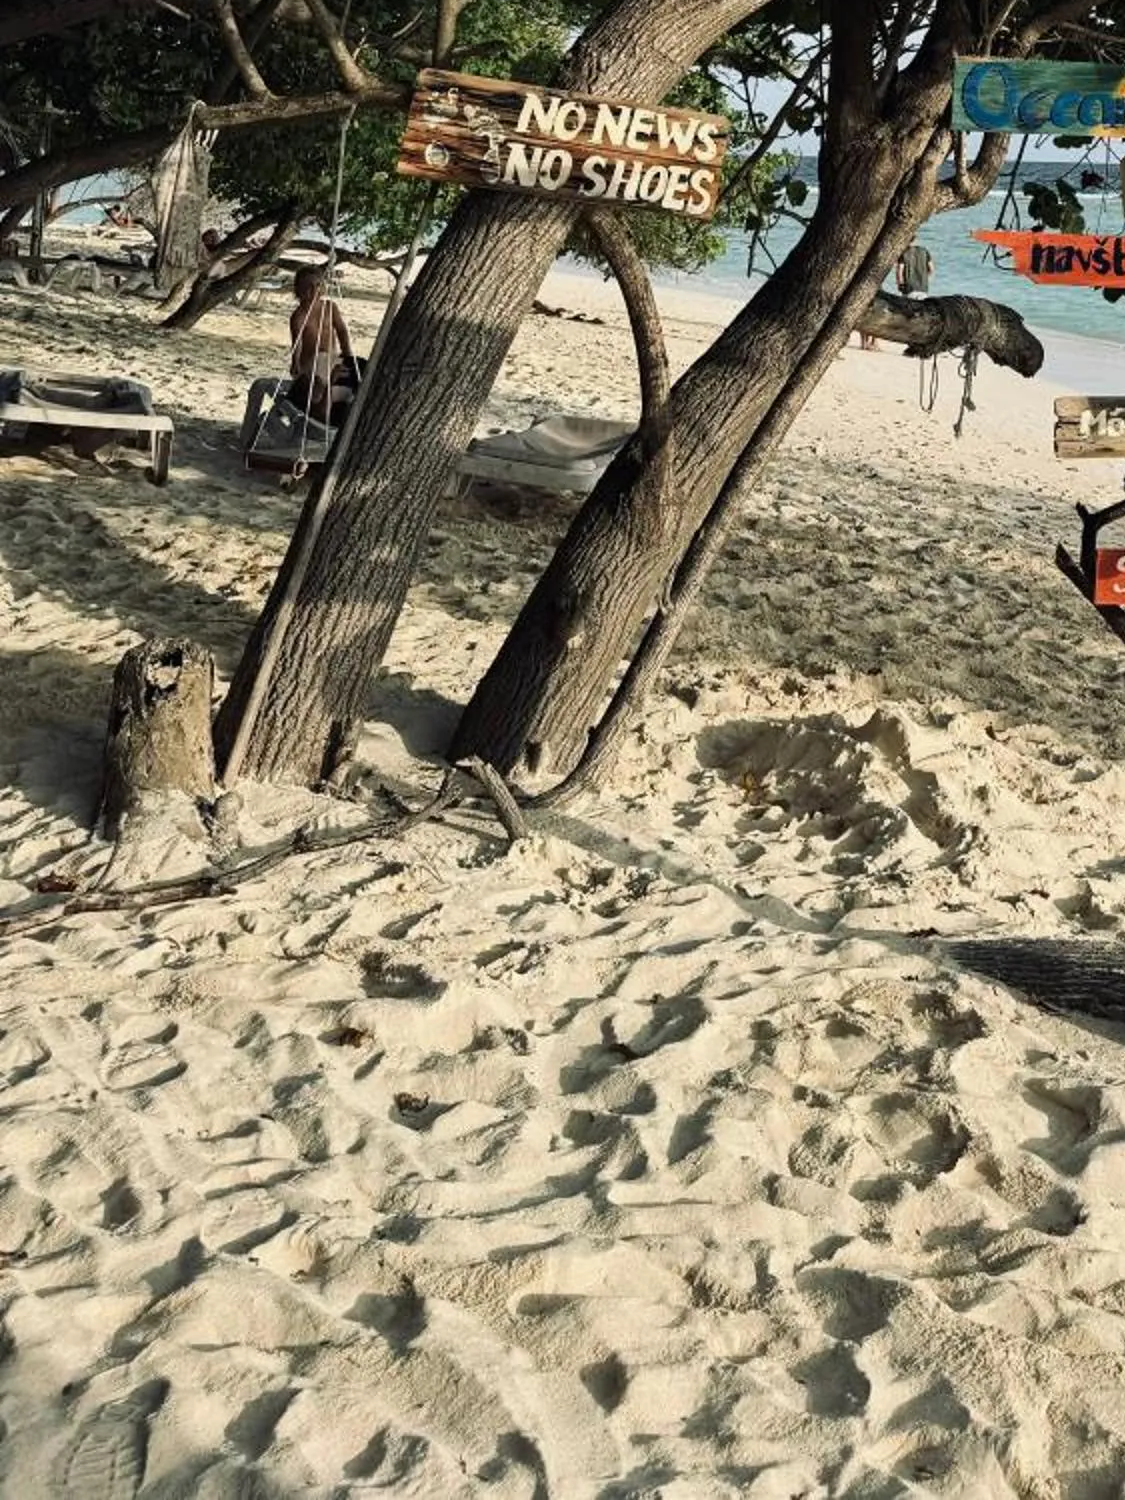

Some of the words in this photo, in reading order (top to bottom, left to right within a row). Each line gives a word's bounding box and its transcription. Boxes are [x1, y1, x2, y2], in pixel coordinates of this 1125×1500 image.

[516, 92, 588, 142] NO
[590, 103, 719, 163] NEWS
[503, 142, 574, 192] NO
[577, 155, 716, 216] SHOES
